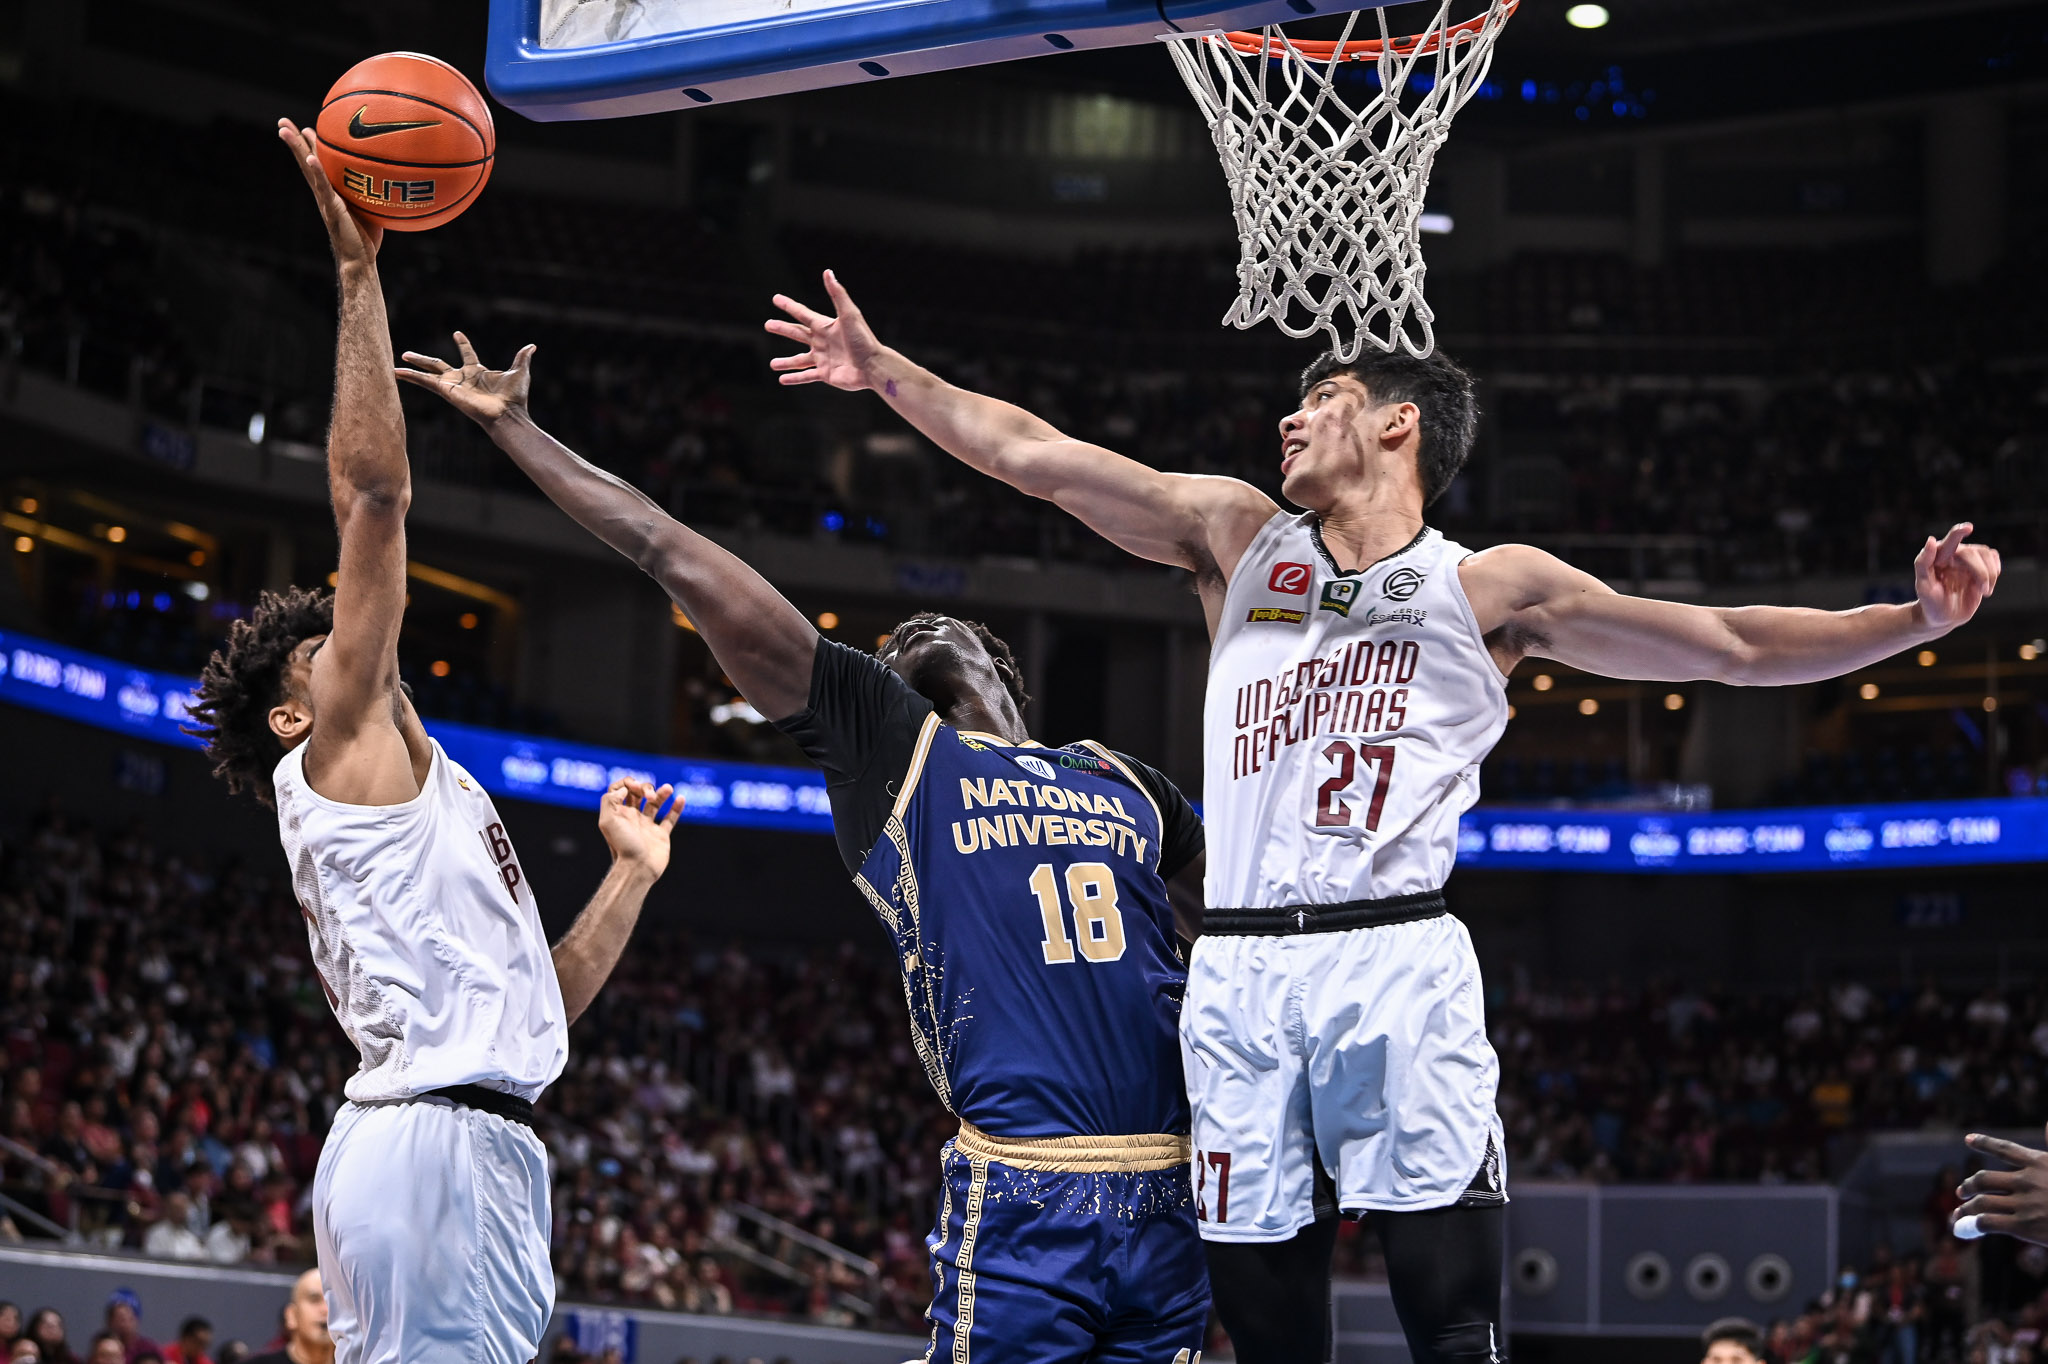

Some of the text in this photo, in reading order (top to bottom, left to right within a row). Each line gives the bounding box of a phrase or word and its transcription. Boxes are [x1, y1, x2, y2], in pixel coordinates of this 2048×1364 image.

[344, 167, 435, 203] ELITE
[1249, 608, 1305, 623] TopBreed
[1059, 755, 1099, 769] OMNI
[1316, 740, 1396, 832] 27
[960, 777, 1137, 825] NATIONAL
[952, 813, 1148, 865] UNIVERSITY
[1028, 862, 1127, 965] 18
